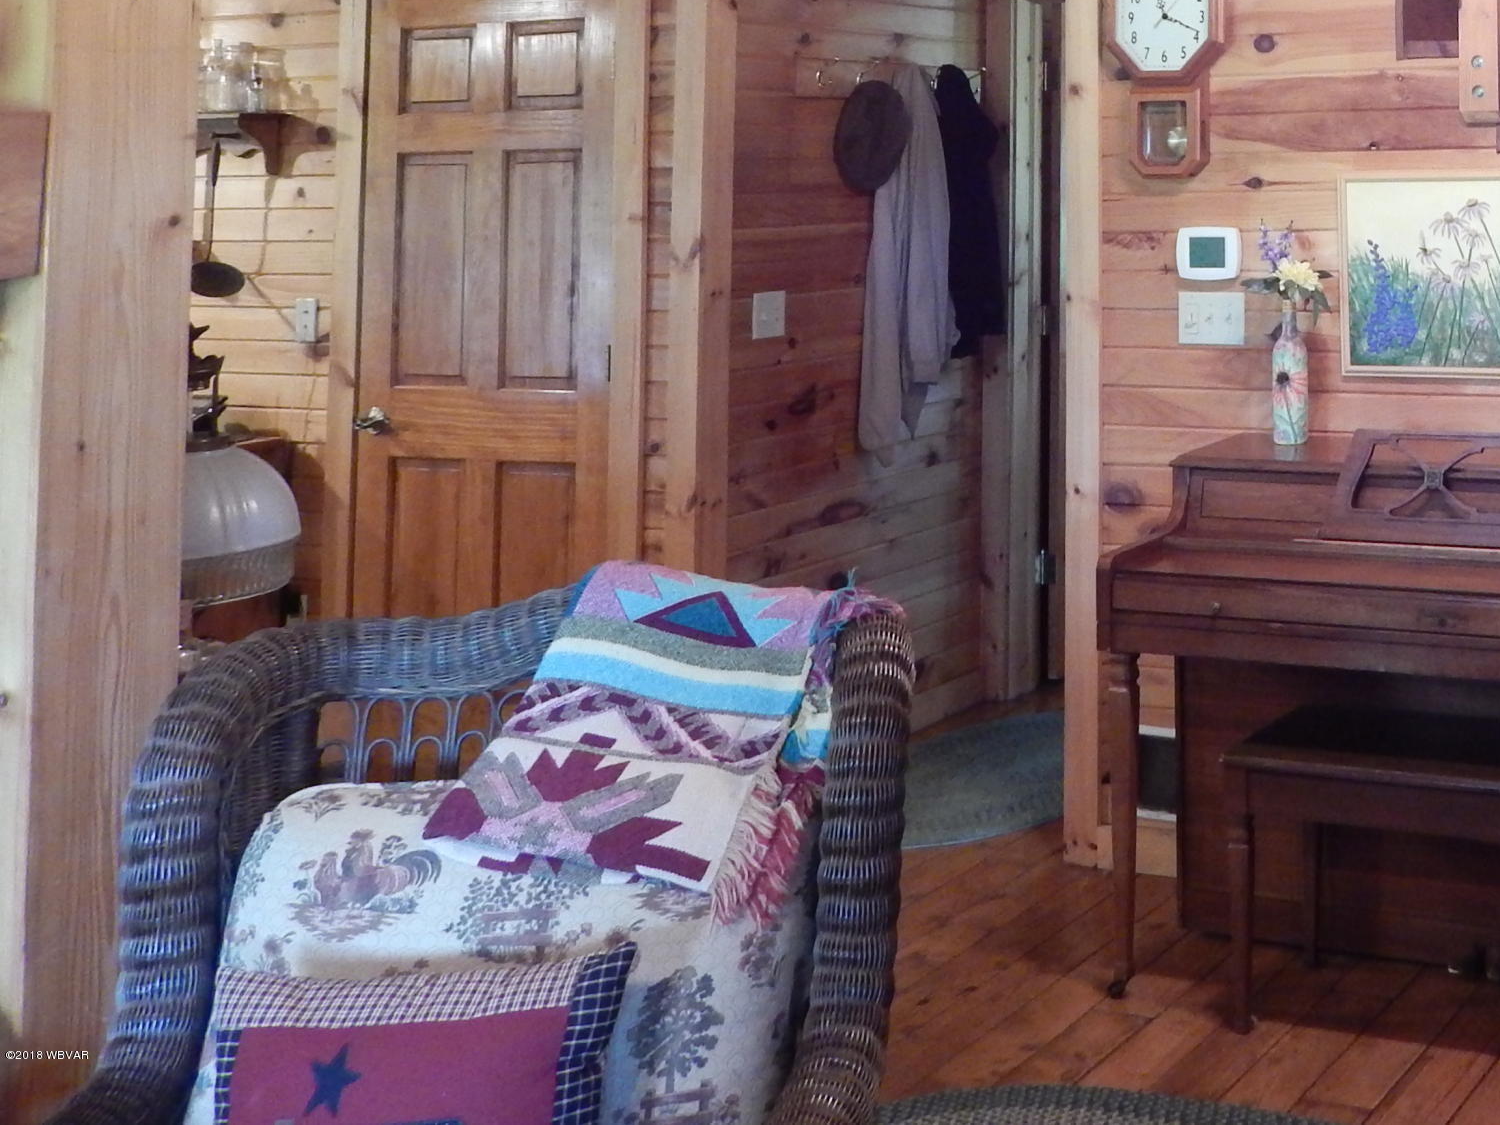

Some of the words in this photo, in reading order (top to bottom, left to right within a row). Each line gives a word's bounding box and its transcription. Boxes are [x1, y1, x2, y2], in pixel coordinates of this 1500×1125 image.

[1128, 12, 1134, 25] 9
[1199, 10, 1205, 24] 3
[1131, 31, 1138, 44] 8
[1144, 47, 1150, 60] 7
[1161, 50, 1168, 62] 6
[1181, 46, 1187, 59] 5
